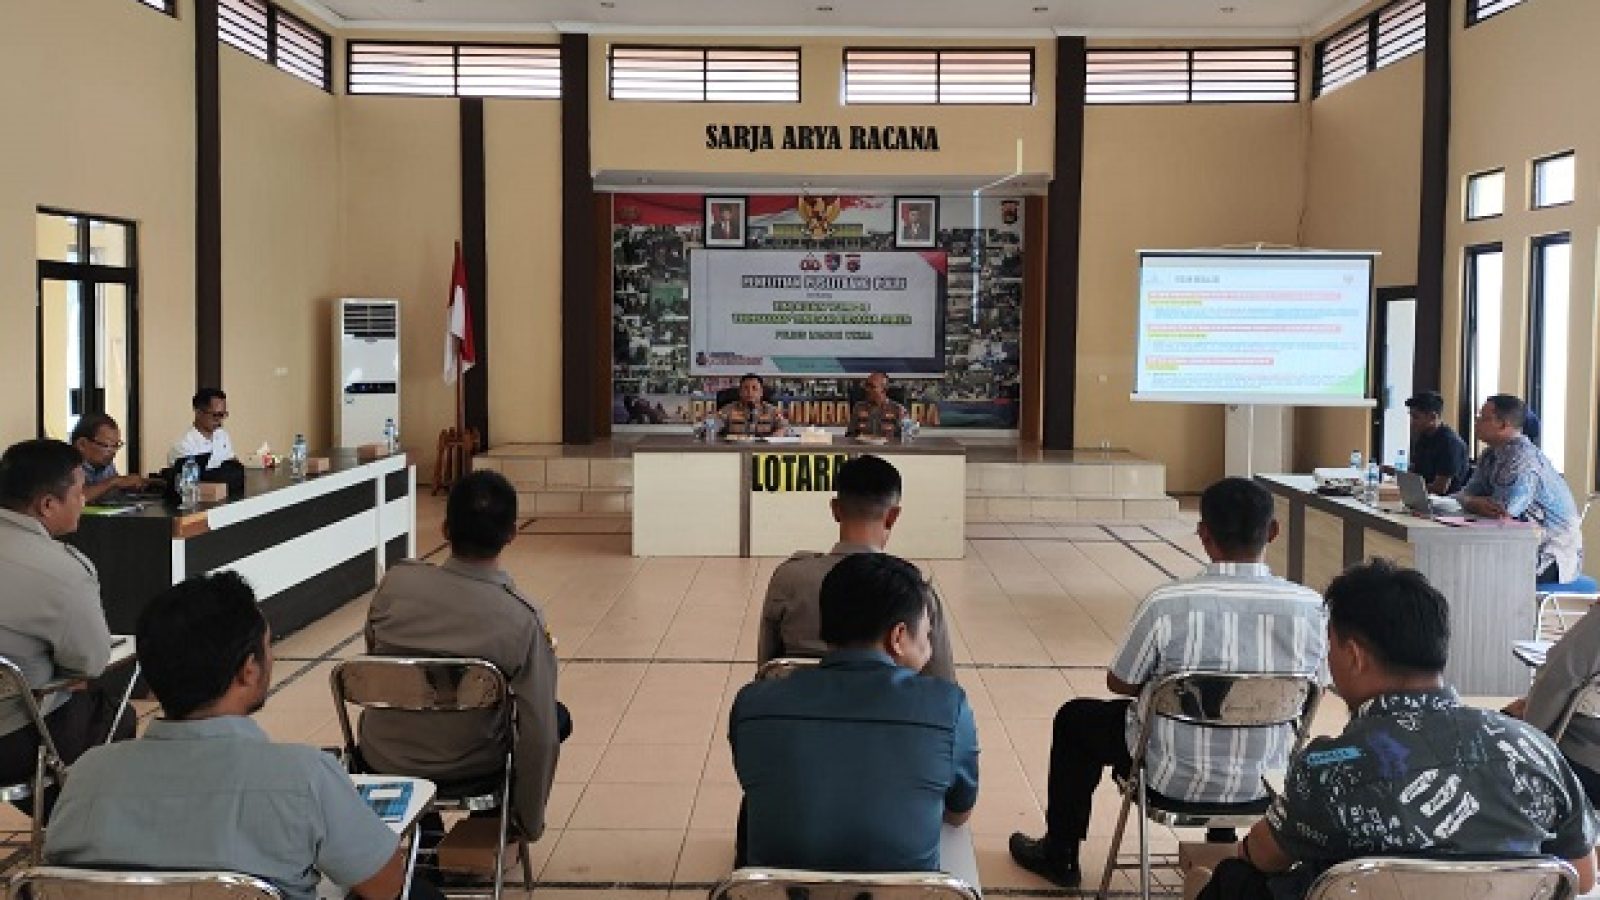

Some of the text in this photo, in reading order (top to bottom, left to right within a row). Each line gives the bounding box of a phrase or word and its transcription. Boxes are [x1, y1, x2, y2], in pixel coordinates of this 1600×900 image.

[706, 124, 940, 152] SARJA ARYA RACANA
